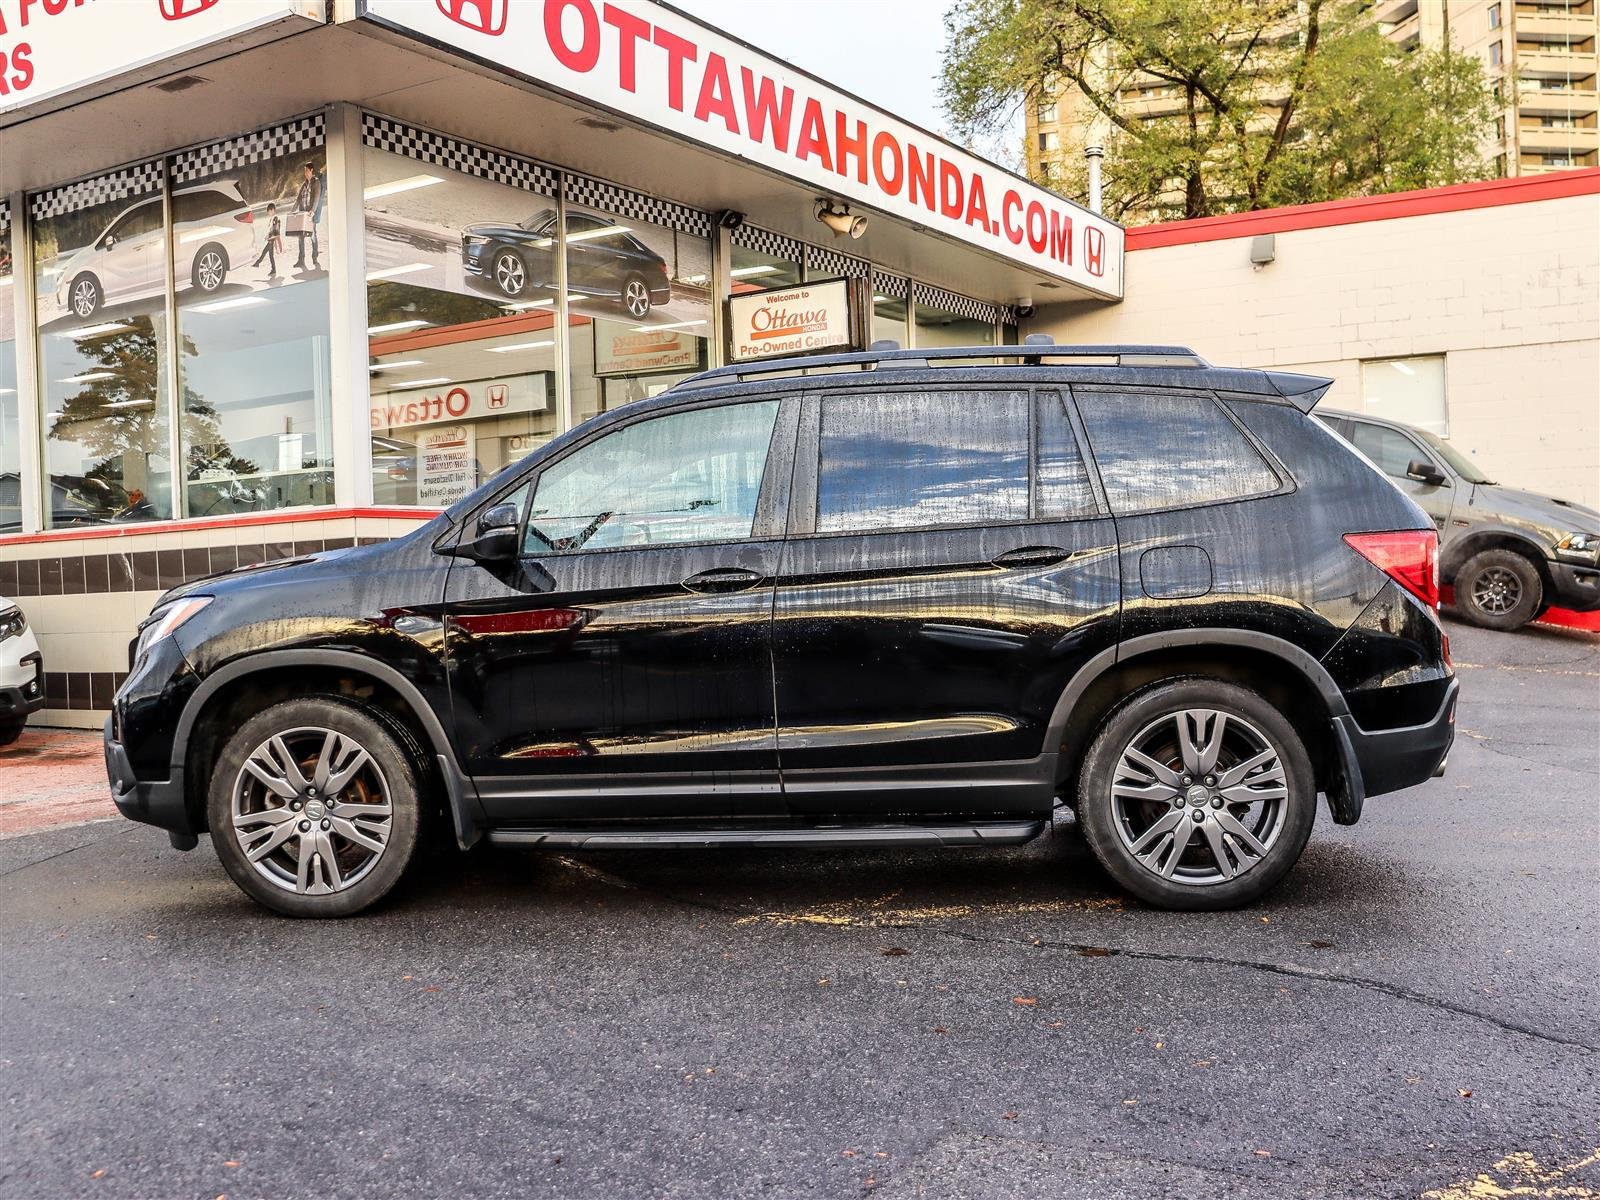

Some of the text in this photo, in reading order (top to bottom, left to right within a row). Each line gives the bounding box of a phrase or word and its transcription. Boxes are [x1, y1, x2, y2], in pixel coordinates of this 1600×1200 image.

[543, 0, 1073, 267] OTTAWAHONDA.COM
[766, 290, 810, 304] Welcome to
[751, 306, 827, 331] Ottawa
[802, 322, 827, 333] HONDA
[740, 333, 844, 356] Pre-Owned Centre
